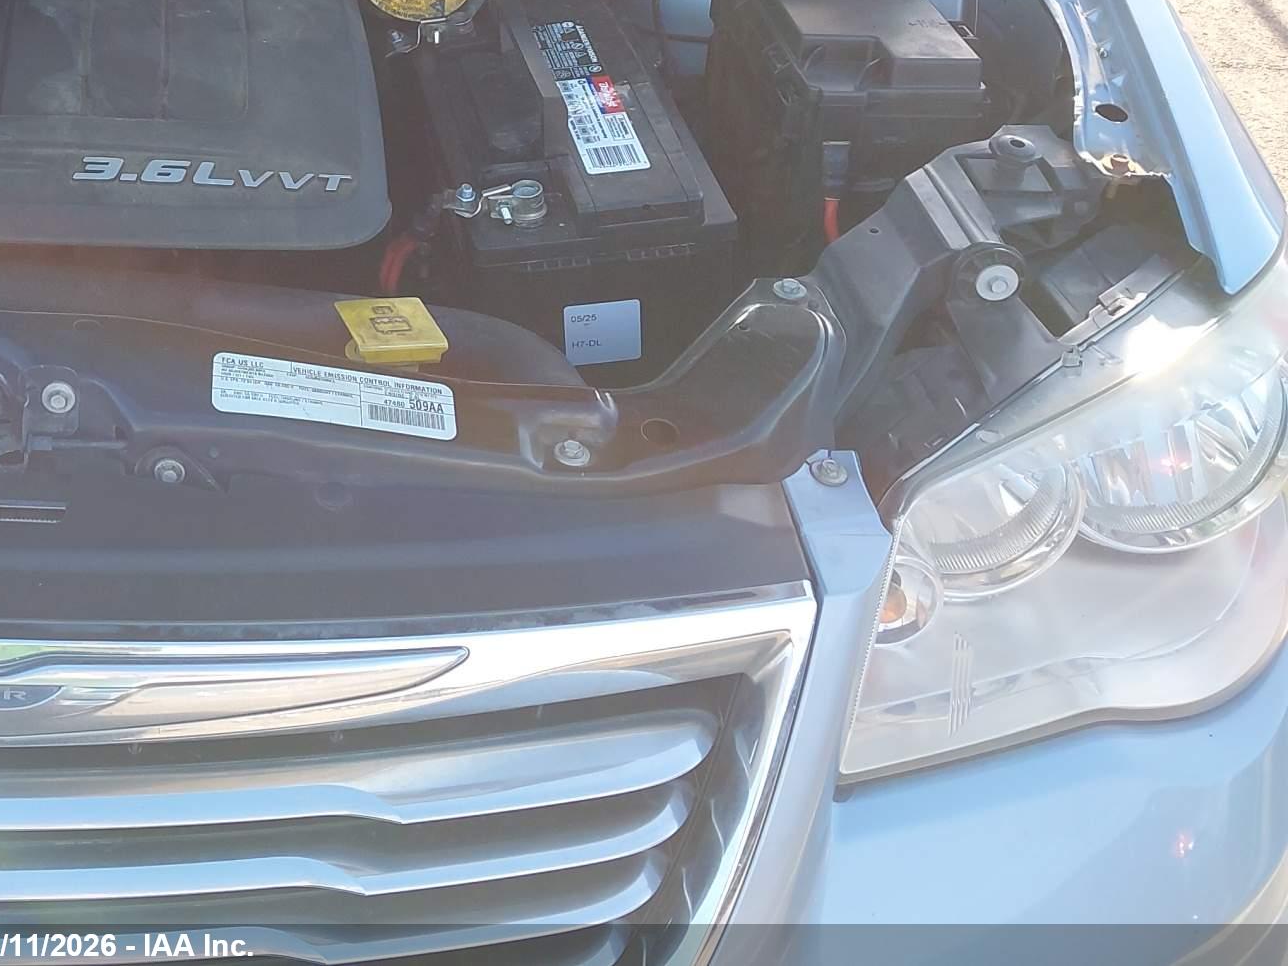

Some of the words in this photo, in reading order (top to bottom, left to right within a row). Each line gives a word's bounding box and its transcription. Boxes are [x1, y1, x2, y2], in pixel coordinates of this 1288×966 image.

[571, 315, 597, 323] 05/25
[221, 356, 237, 365] FCA
[238, 359, 249, 367] US
[292, 366, 321, 378] VEHICLE
[323, 370, 358, 383] EMISSION
[359, 375, 391, 388] CONTROL
[393, 380, 443, 395] INFORMATION
[408, 398, 445, 414] 509AA
